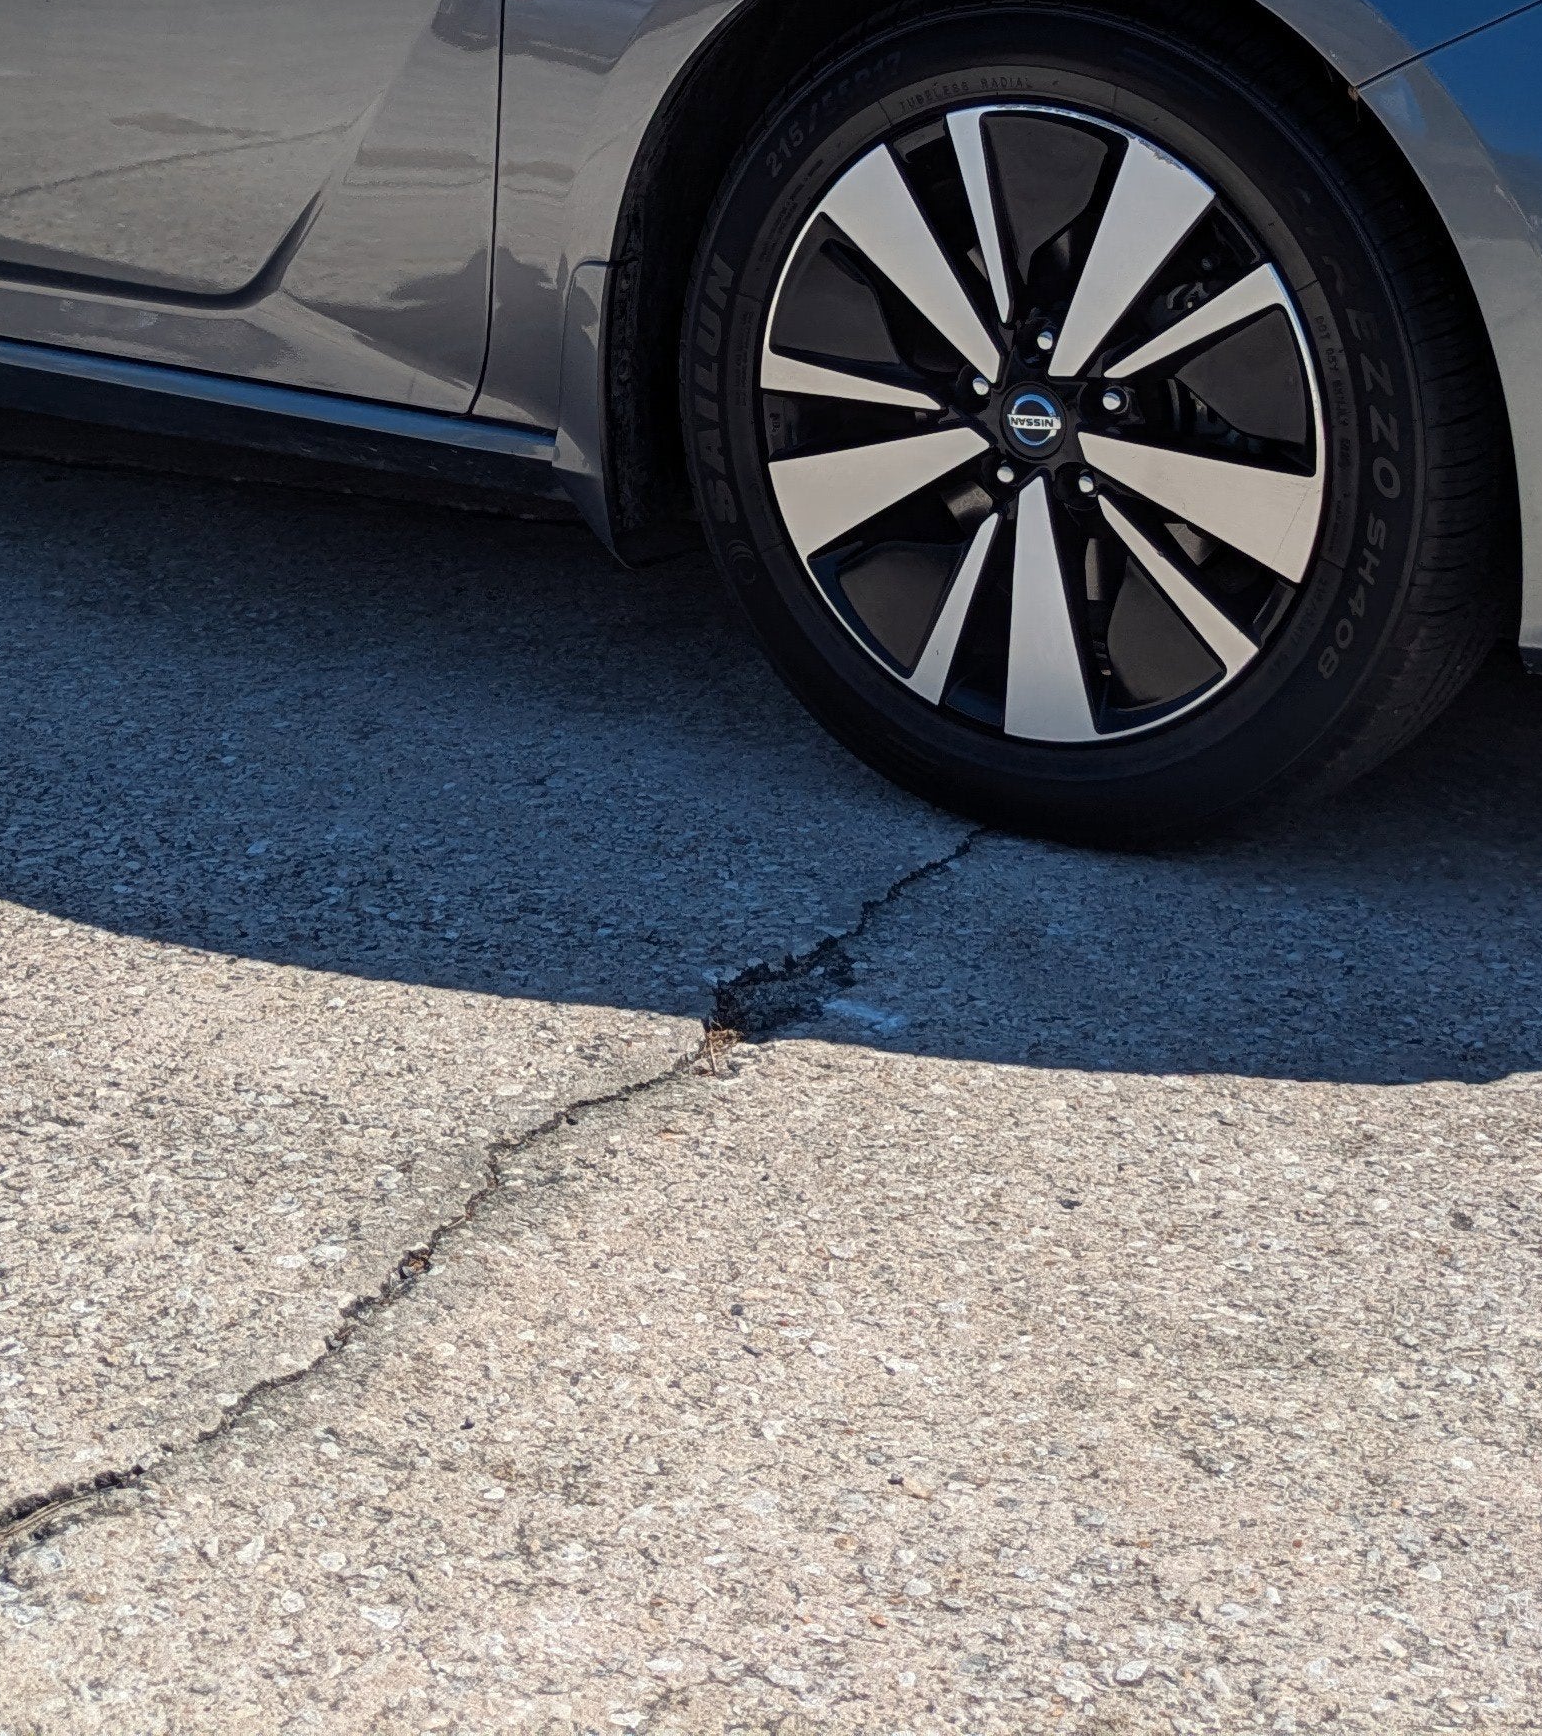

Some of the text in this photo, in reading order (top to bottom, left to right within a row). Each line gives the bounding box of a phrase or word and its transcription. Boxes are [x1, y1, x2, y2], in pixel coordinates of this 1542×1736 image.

[900, 75, 1033, 114] TUBELESS RADIAL
[694, 252, 739, 524] SAILUN
[1010, 416, 1054, 428] NISSAN
[1317, 510, 1387, 681] SH408
